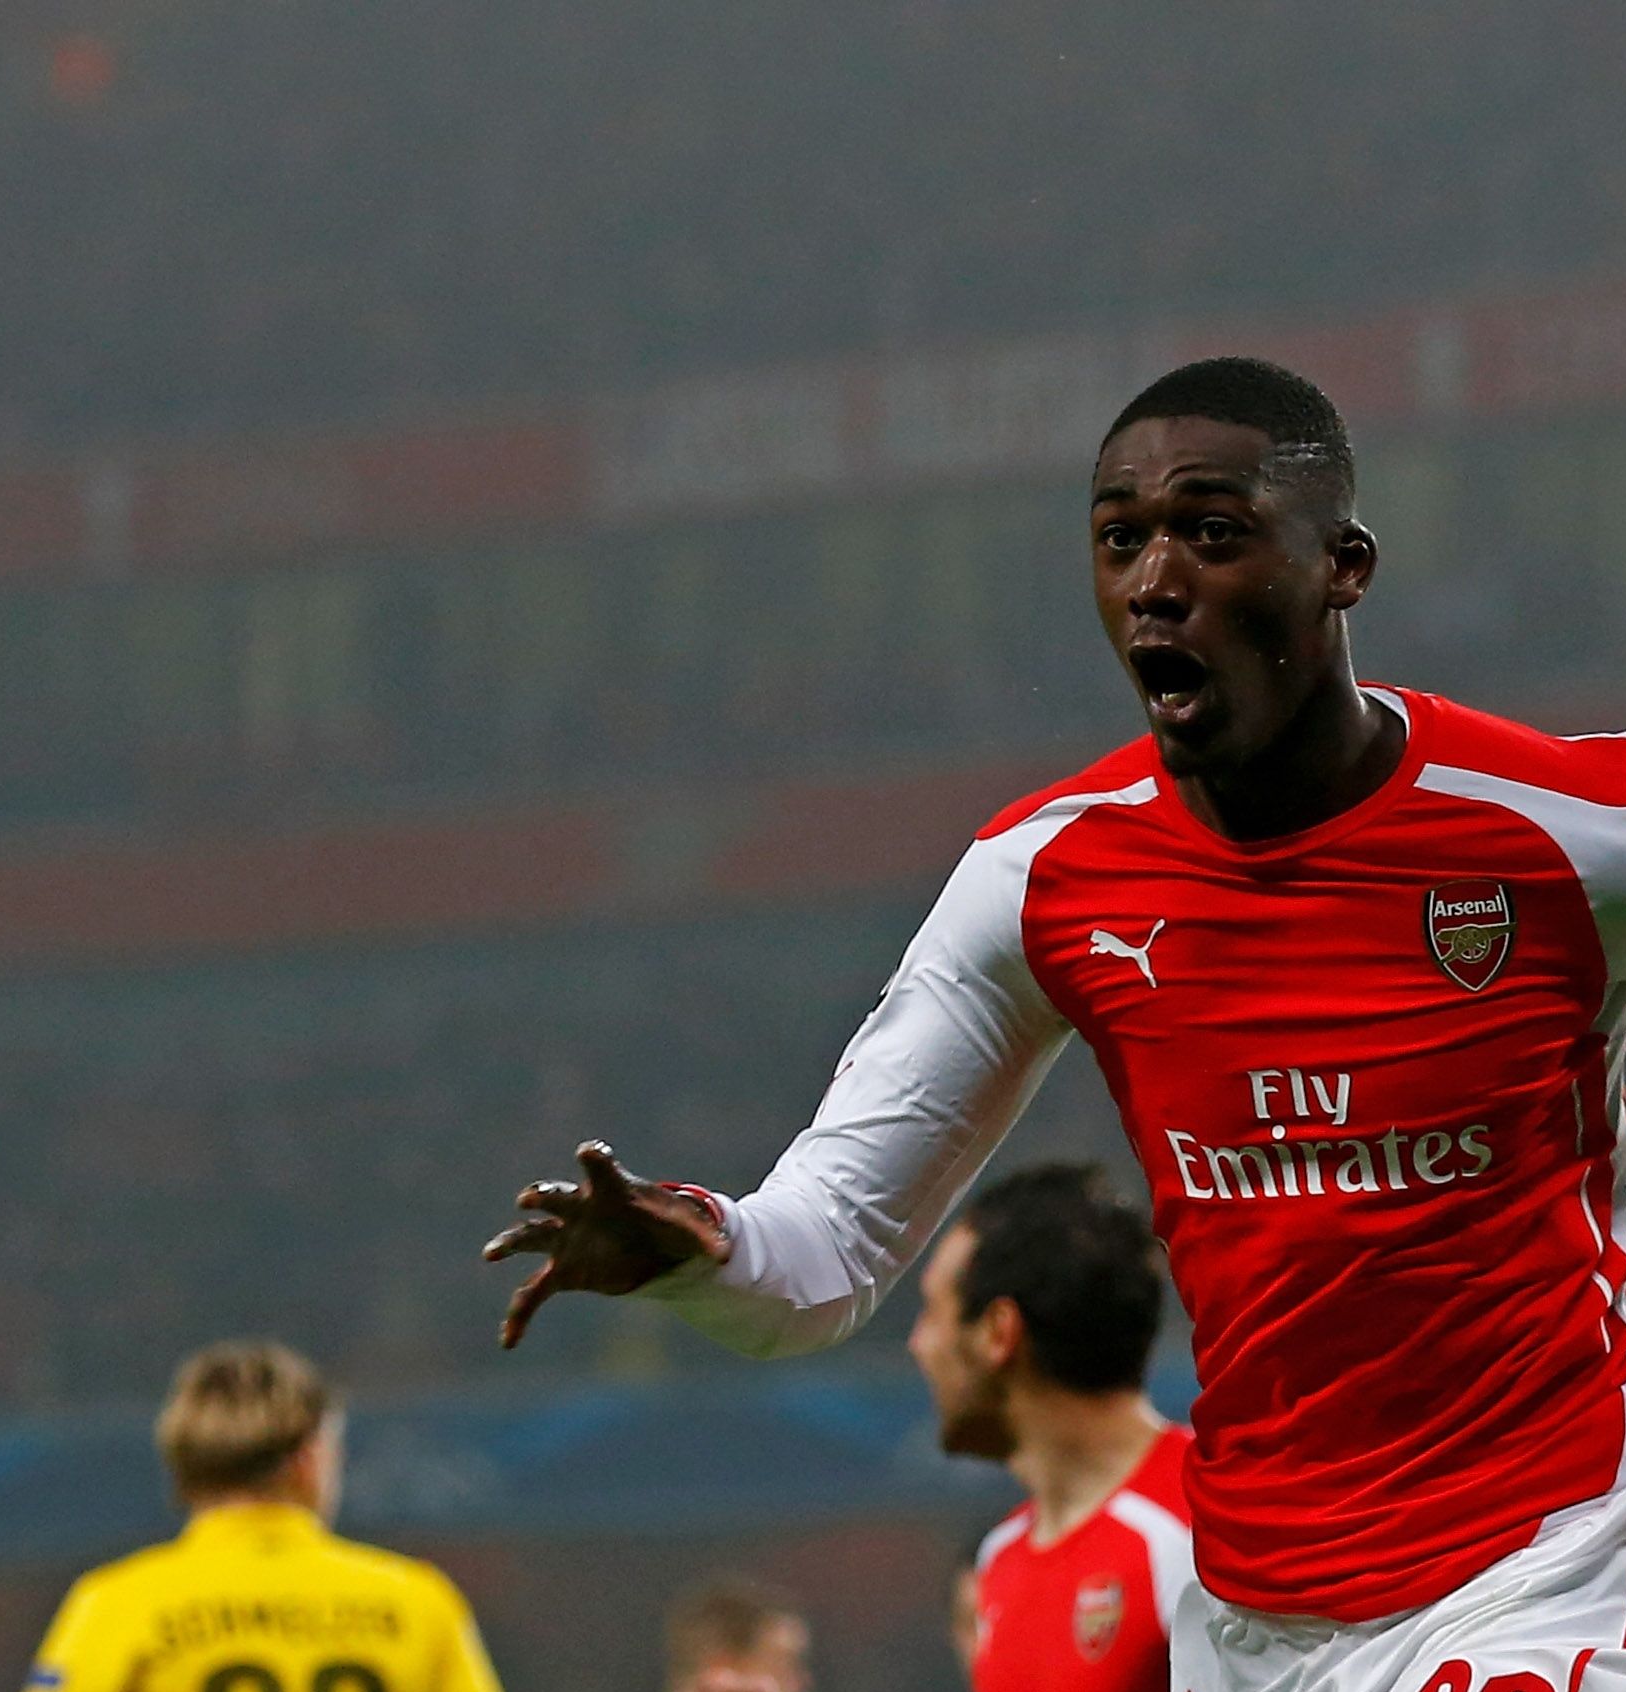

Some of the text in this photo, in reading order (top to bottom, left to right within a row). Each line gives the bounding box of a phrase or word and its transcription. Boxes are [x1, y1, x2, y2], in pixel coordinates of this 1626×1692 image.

[1434, 895, 1503, 917] Arsenal
[1248, 1068, 1350, 1125] Fly
[1164, 1124, 1492, 1199] Emirates
